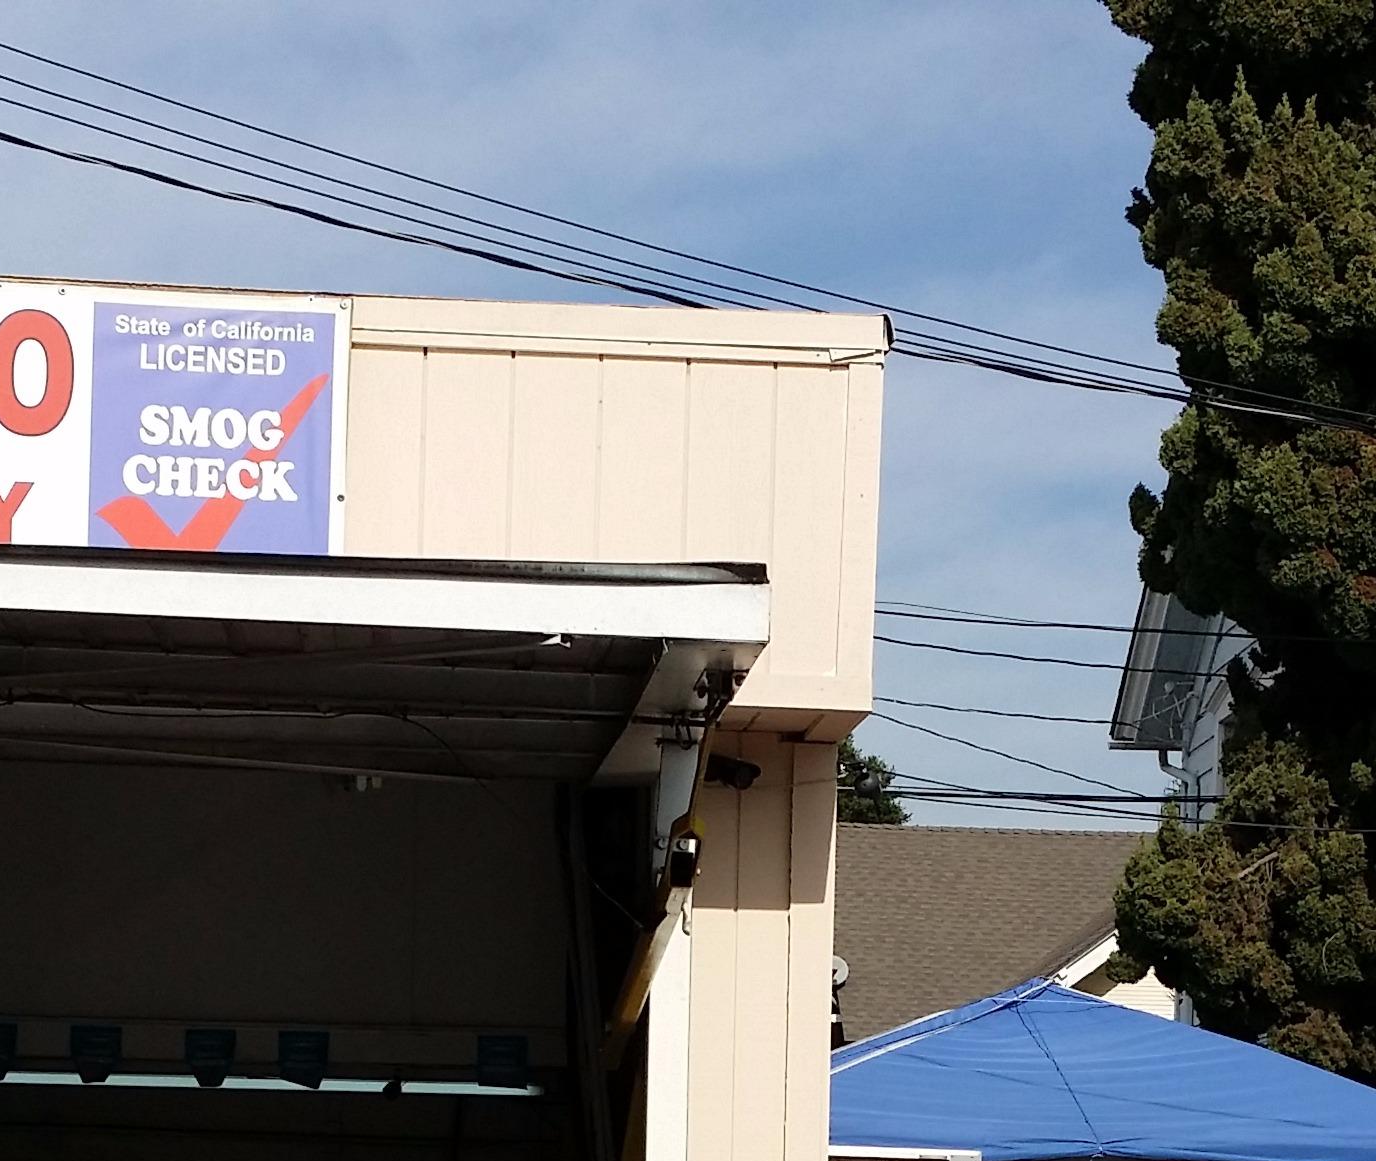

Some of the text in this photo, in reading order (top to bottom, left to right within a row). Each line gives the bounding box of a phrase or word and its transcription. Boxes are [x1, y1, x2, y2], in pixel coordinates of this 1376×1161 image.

[114, 314, 315, 343] State of California
[140, 343, 286, 376] LICENSED
[139, 404, 285, 451] SMOG
[123, 454, 298, 502] CHECK
